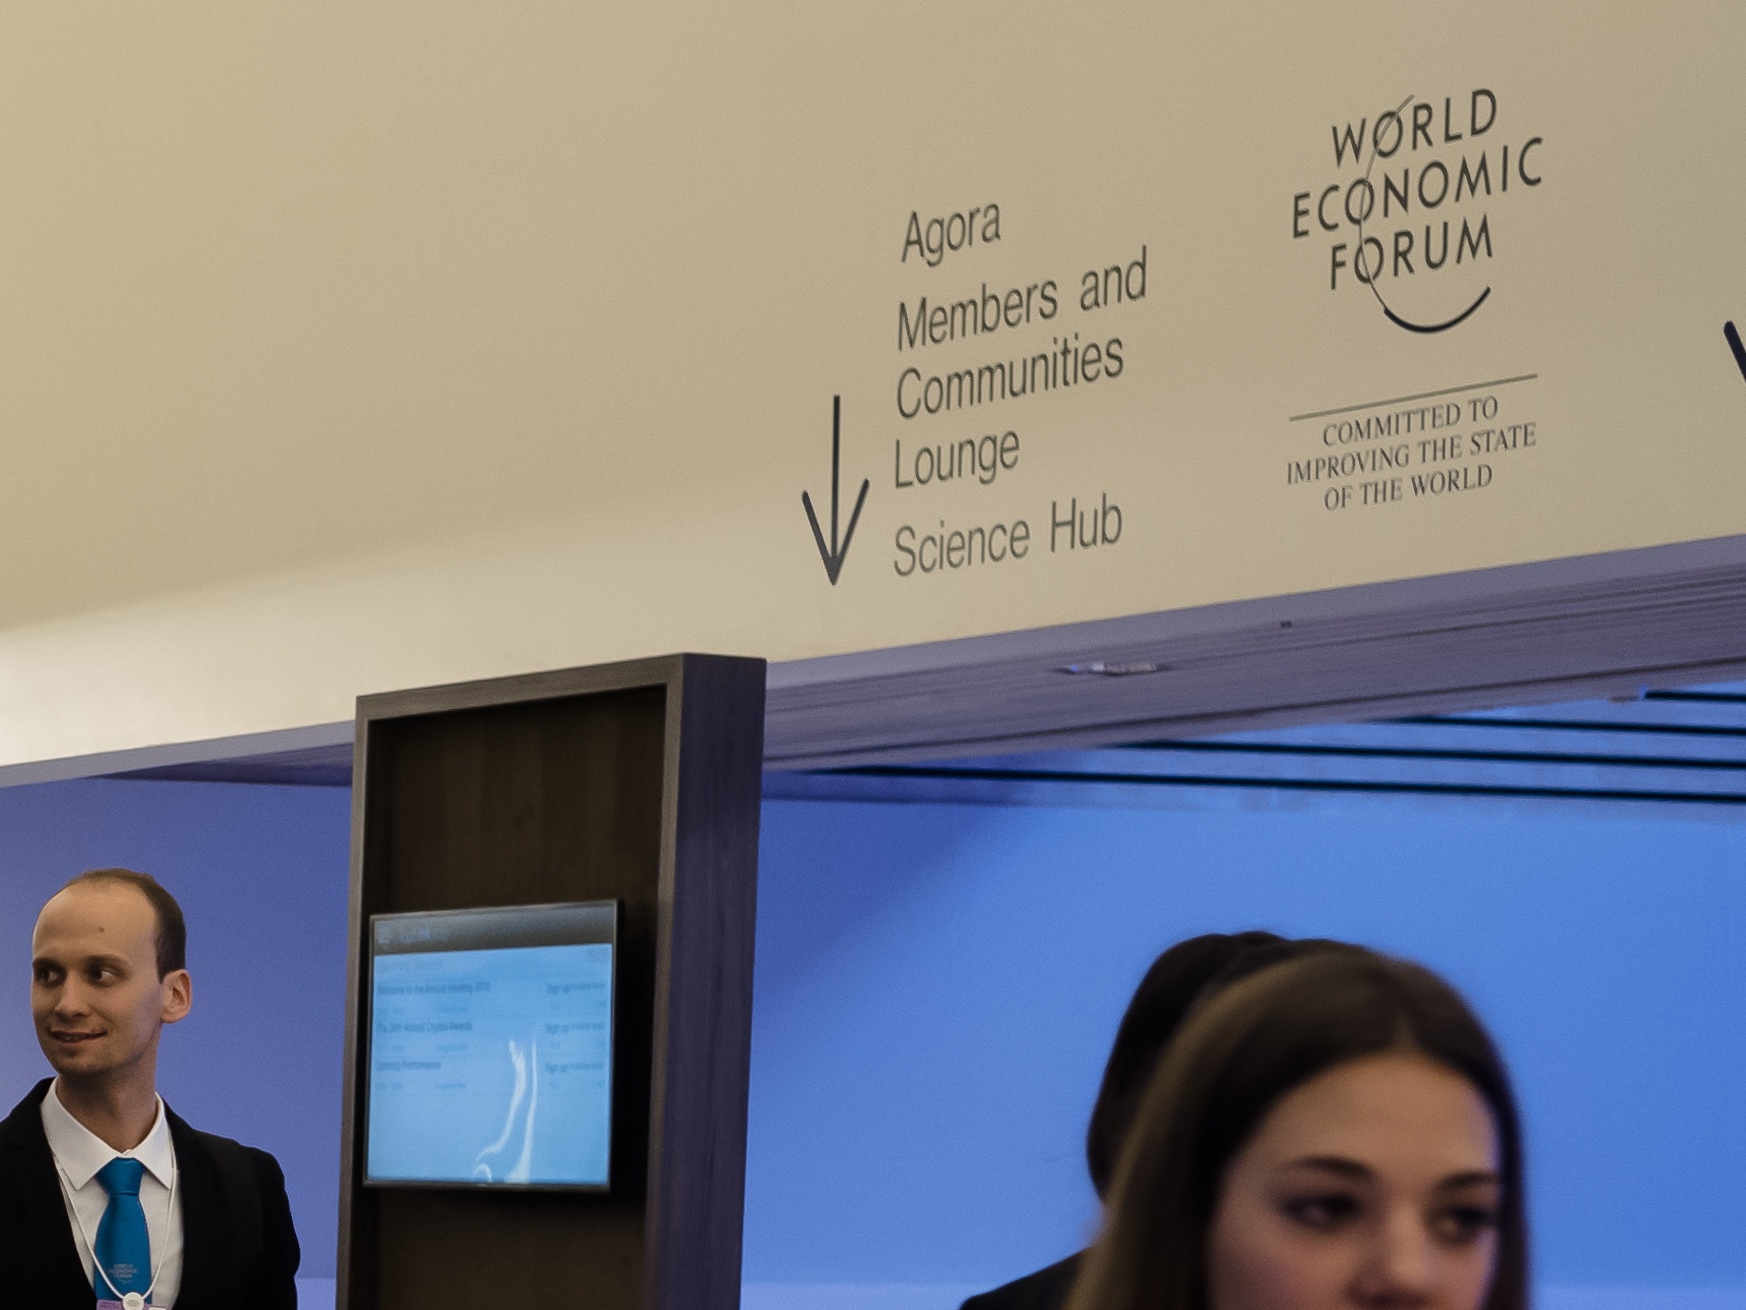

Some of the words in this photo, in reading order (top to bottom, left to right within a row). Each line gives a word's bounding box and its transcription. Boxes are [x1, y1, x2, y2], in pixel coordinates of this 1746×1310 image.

[1332, 88, 1498, 169] WORLD
[1293, 137, 1544, 239] ECONOMIC
[901, 202, 1002, 268] Agora
[1330, 212, 1494, 290] FORUM
[897, 278, 1059, 352] Members
[1078, 244, 1148, 313] and
[896, 332, 1125, 420] Communities
[894, 427, 1021, 490] Lounge
[1287, 443, 1410, 485] IMPROVING
[1417, 434, 1463, 464] THE
[1469, 421, 1537, 457] STATE
[1323, 402, 1462, 447] COMMITTED
[1468, 394, 1499, 423] TO
[1324, 484, 1354, 512] OF
[1359, 476, 1404, 506] THE
[1410, 463, 1493, 498] WORLD
[892, 519, 1031, 578] Science
[1050, 491, 1124, 553] Hub
